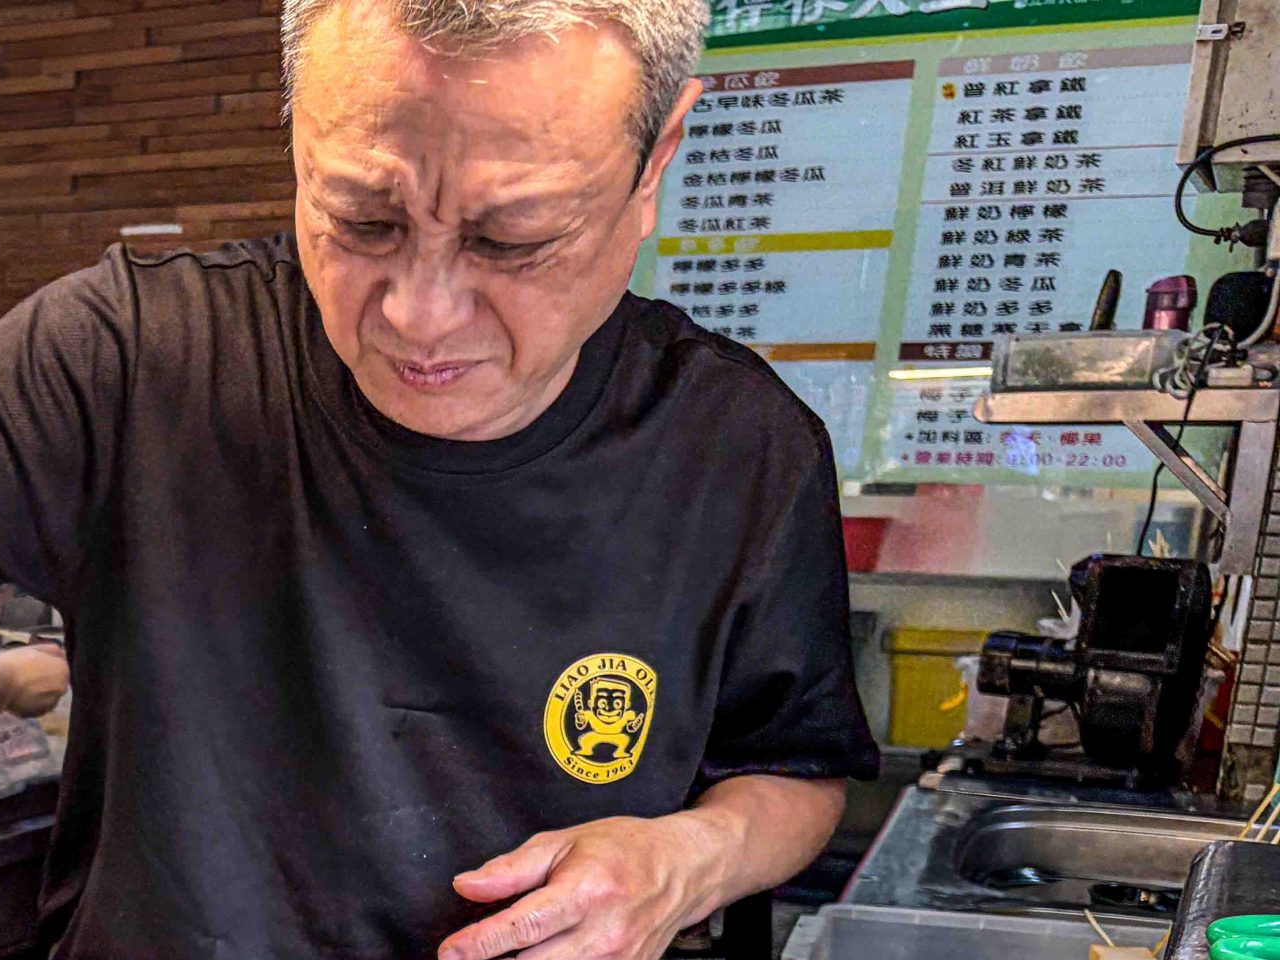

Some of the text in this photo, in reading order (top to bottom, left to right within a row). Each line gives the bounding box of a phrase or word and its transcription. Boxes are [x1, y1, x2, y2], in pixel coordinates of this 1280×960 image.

[691, 88, 845, 113] 古早味冬瓜茶
[957, 104, 1082, 124] 紅茶拿鐵
[688, 119, 783, 139] 檸檬冬瓜
[954, 129, 1079, 149] 紅玉拿鐵
[685, 144, 780, 164] 金桔冬瓜
[682, 165, 826, 187] 金桔檸檬冬瓜
[678, 216, 772, 233] 冬瓜紅茶
[940, 228, 1065, 245] 鮮奶綠茶
[934, 276, 1056, 293] 鮮奶冬瓜
[680, 303, 759, 318] 桔多多
[929, 300, 1053, 317] 鮮奶多多
[555, 664, 589, 702] LIAO
[598, 658, 627, 672] JIA
[564, 756, 599, 779] Since
